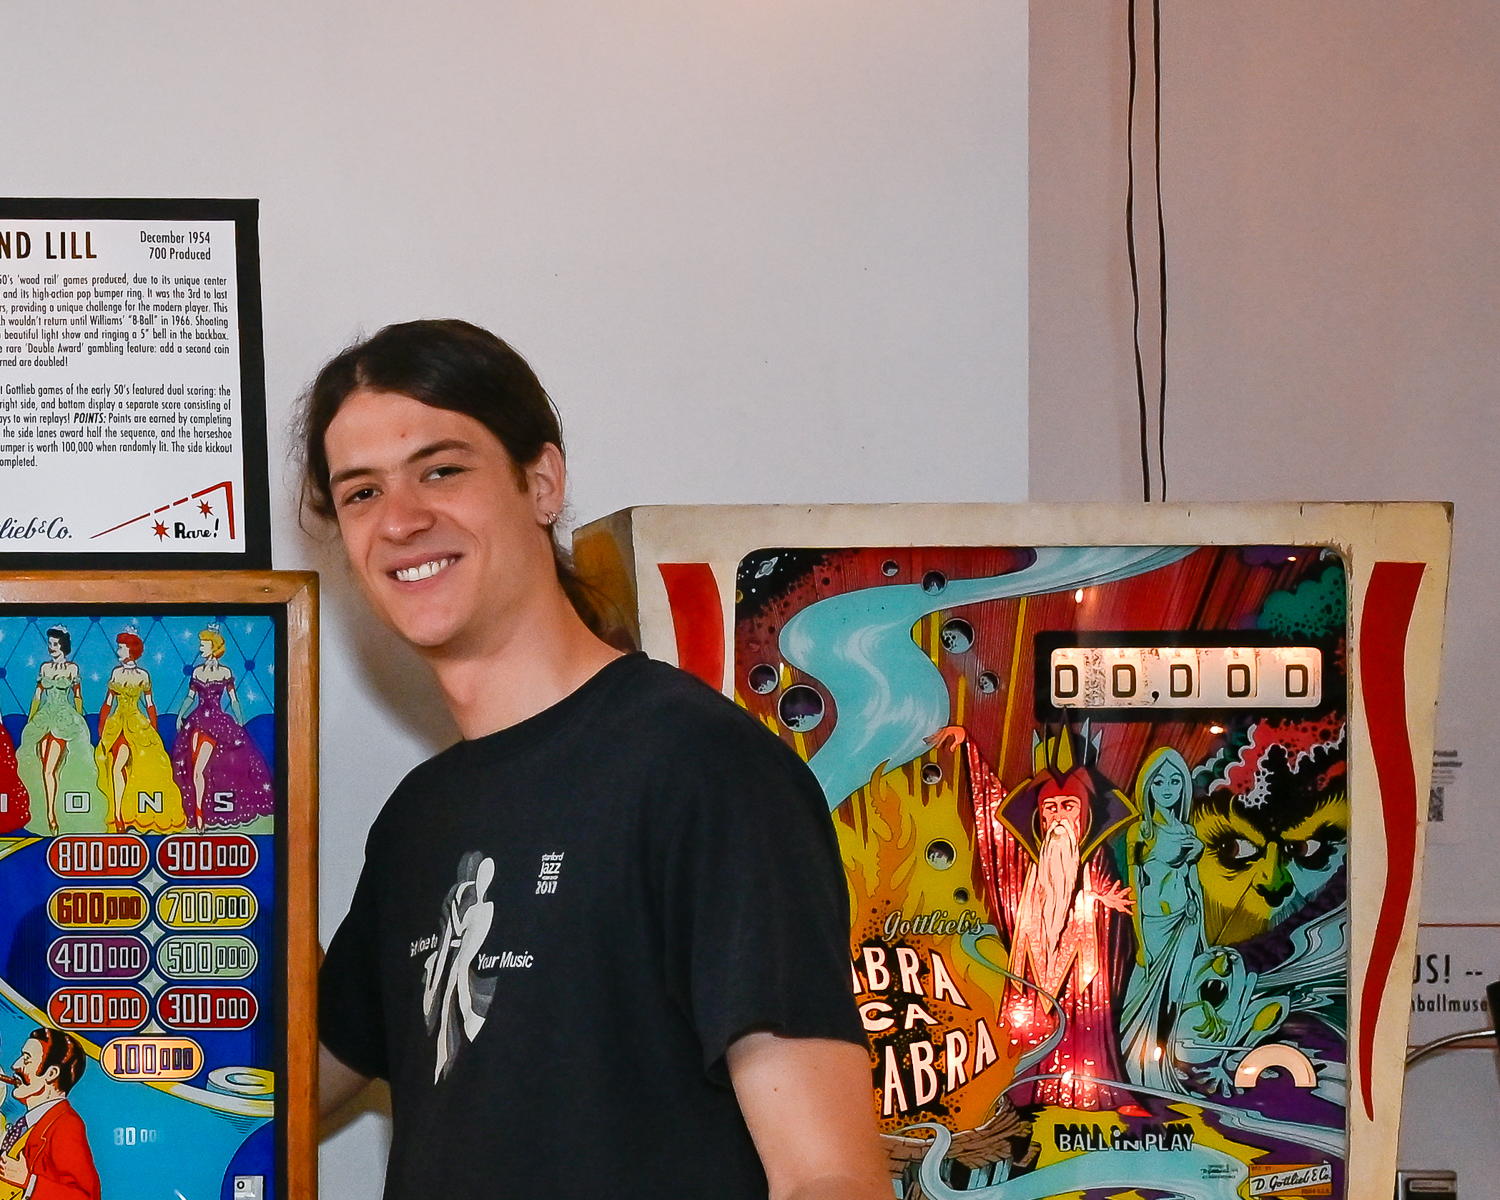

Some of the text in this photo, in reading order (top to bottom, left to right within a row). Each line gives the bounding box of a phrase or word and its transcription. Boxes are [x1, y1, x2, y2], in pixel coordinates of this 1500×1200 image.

[45, 231, 98, 259] LILL
[140, 230, 210, 244] December 1954
[149, 247, 211, 260] 700 Produced
[62, 277, 88, 287] games
[91, 274, 129, 287] produced,
[132, 274, 148, 284] due
[150, 275, 158, 284] to
[161, 274, 171, 285] its
[174, 275, 200, 287] unique
[203, 276, 227, 285] center
[174, 518, 219, 539] Rare!
[881, 910, 983, 942] Gottlieb's
[478, 950, 534, 970] Your Music
[858, 1001, 939, 1032] CA
[113, 1044, 194, 1076] 100,000
[1059, 1133, 1109, 1151] BALL
[1145, 1133, 1193, 1151] PLAY
[1270, 1170, 1309, 1191] Gottlieb
